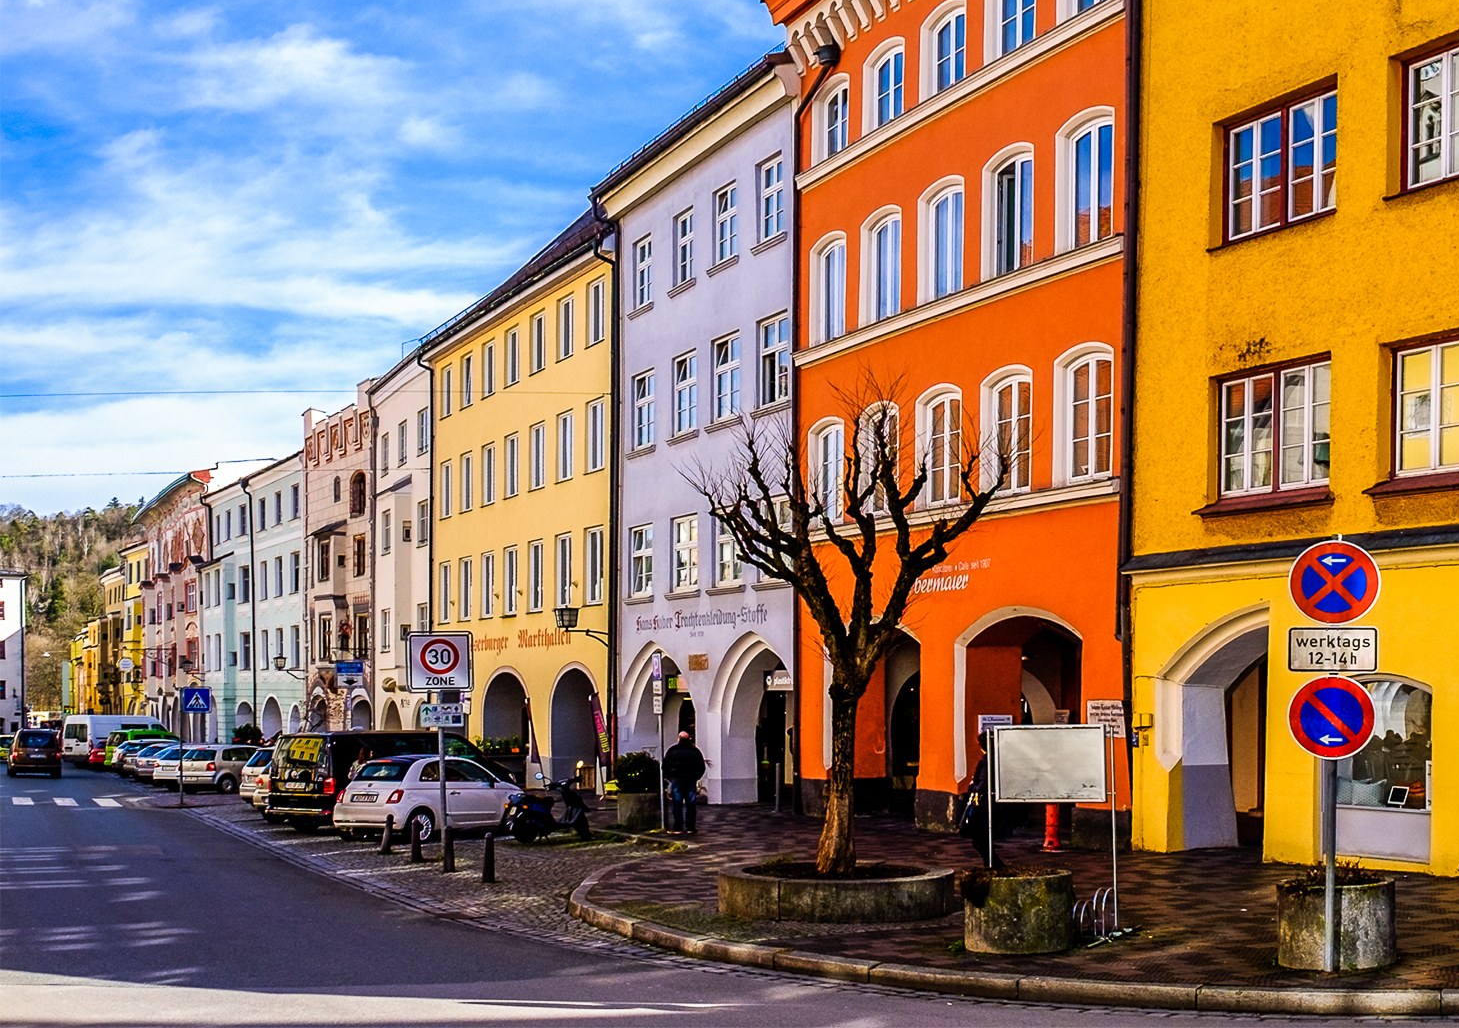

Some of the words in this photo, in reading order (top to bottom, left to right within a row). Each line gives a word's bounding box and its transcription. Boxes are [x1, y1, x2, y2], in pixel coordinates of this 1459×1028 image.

[1296, 635, 1371, 651] werktags
[427, 648, 451, 665] 30
[425, 677, 455, 686] ZONE
